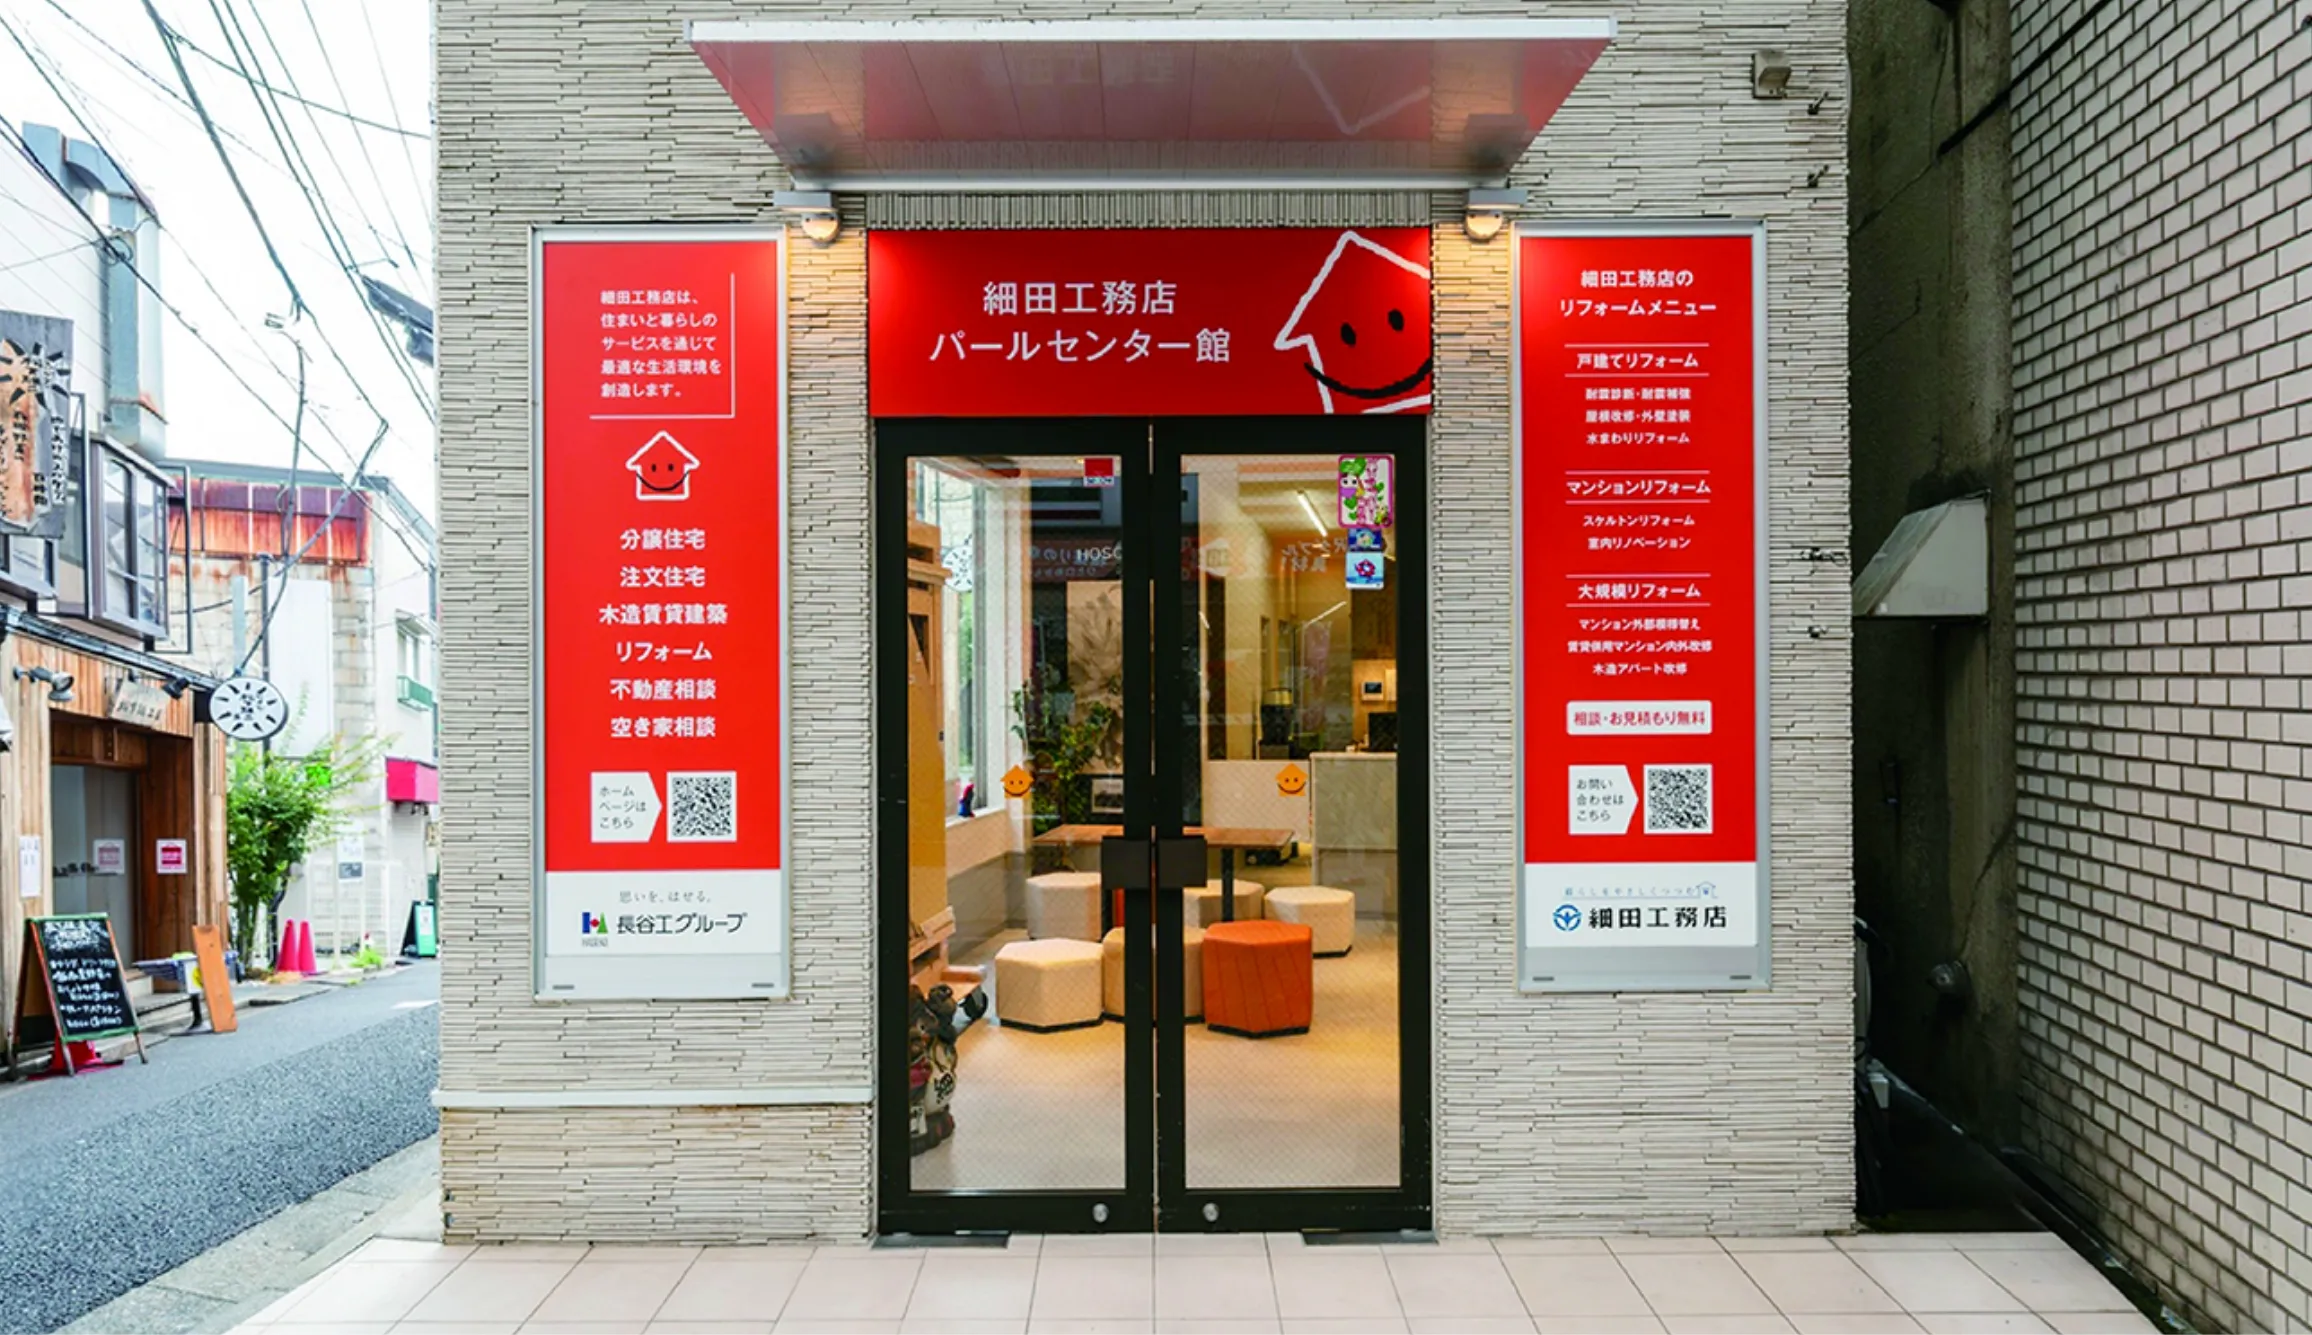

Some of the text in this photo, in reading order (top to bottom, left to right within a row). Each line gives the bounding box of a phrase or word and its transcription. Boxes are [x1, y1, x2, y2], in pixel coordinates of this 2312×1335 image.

[1580, 269, 1694, 288] 細田工務店の
[600, 290, 699, 305] 細田工務店は、
[983, 280, 1177, 316] 細田工務店
[1560, 299, 1717, 317] リフォームメニュー
[600, 312, 718, 328] 住まいと暮らしの
[601, 336, 717, 351] サービスを通じて
[929, 328, 1231, 362] パールセンター館
[600, 359, 722, 375] 最適な生活環境を
[1577, 353, 1699, 369] 戸建てリフォーム
[600, 382, 682, 398] 創造します。
[1586, 432, 1690, 445] 水まわりリフォーム
[1566, 480, 1711, 495] マンションリフォーム
[1583, 515, 1695, 527] スケルトンリフォーム
[620, 528, 706, 550] 分譲住宅
[1588, 537, 1691, 550] 室内リノベーション
[620, 566, 706, 588] 注文住宅
[1578, 584, 1701, 599] 大規模リフォーム
[599, 603, 728, 625] 木造賃貸建築
[616, 641, 713, 662] リフォーム
[610, 678, 717, 700] 不動産相談
[1574, 711, 1705, 726] 相談・お見積もり無料
[611, 716, 716, 738] 空き家相談
[599, 786, 635, 797] ホーム
[1576, 779, 1613, 790] お問い
[599, 801, 646, 812] ページは
[1576, 794, 1624, 806] 合わせは
[599, 817, 634, 829] こちら
[1576, 810, 1611, 822] こちら
[616, 912, 748, 935] 長谷工グループ
[1588, 905, 1727, 930] 細田工務店
